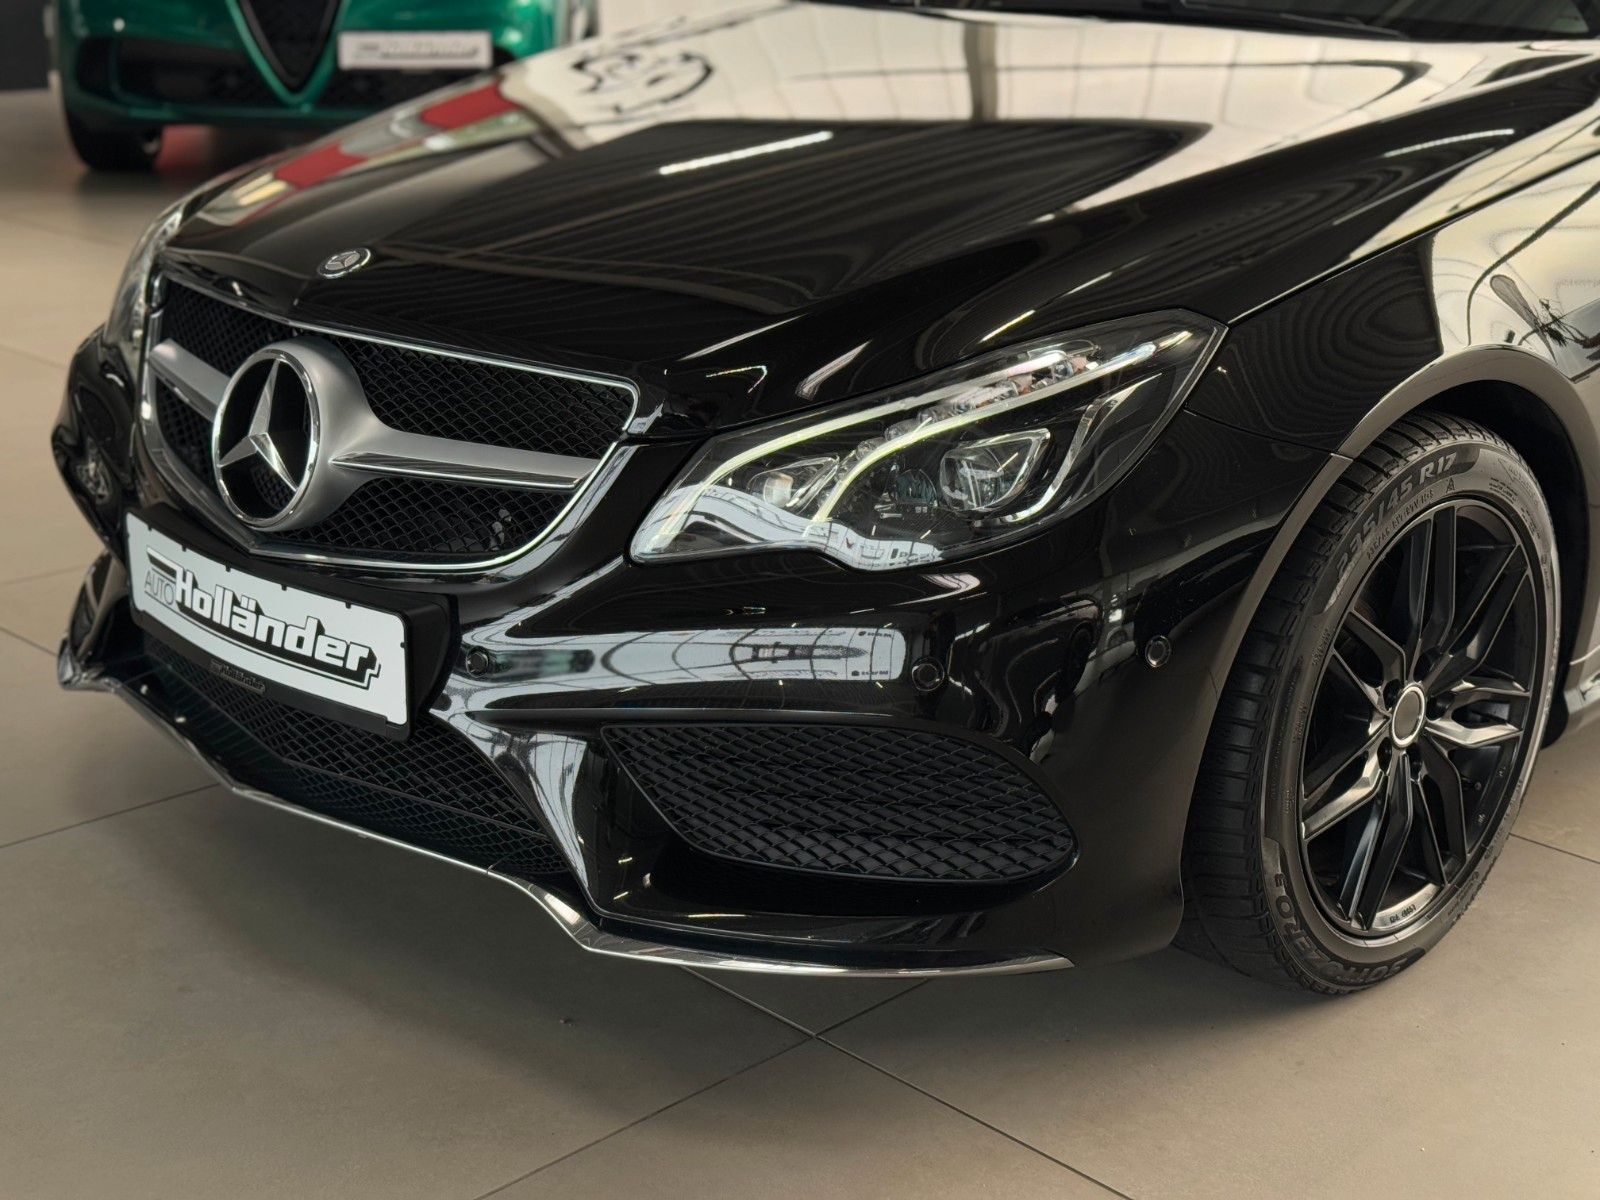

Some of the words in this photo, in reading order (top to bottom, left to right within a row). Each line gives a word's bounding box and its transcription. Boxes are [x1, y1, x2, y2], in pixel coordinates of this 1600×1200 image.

[1336, 475, 1413, 579] 235/45
[1419, 452, 1457, 485] R17
[144, 570, 175, 606] AUTO
[172, 567, 377, 674] Holländer
